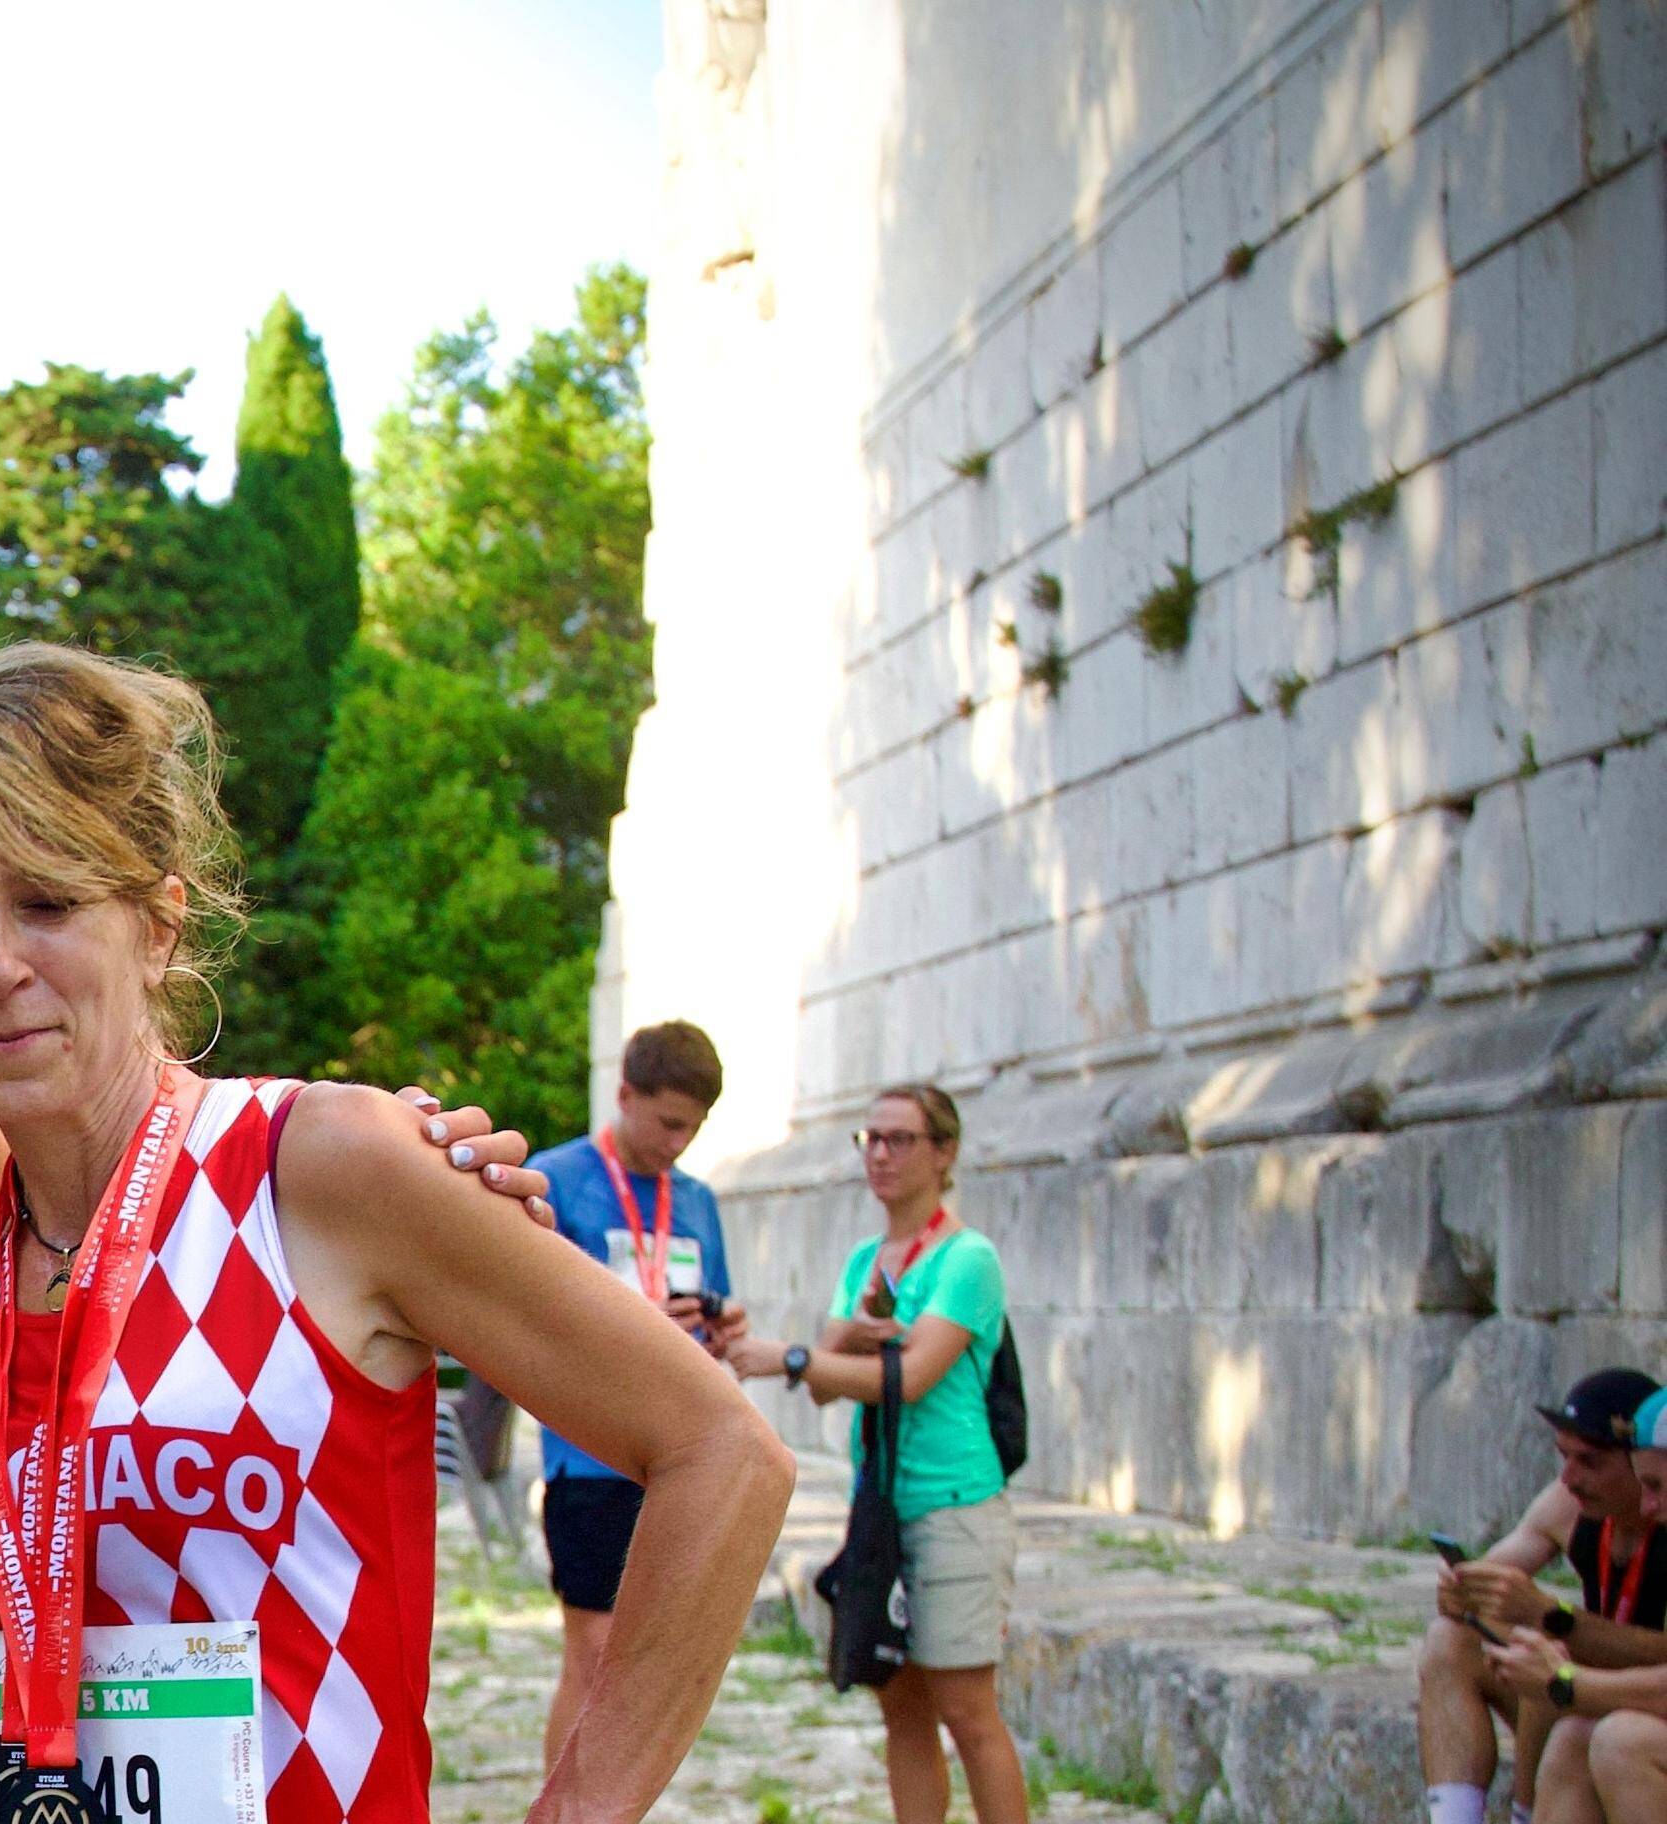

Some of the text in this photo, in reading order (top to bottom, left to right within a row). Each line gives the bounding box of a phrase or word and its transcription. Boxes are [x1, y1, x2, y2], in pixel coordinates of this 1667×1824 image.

[185, 1636, 210, 1653] 10
[83, 1688, 150, 1711] 5 KM
[242, 1721, 252, 1735] PC
[242, 1738, 254, 1773] Course
